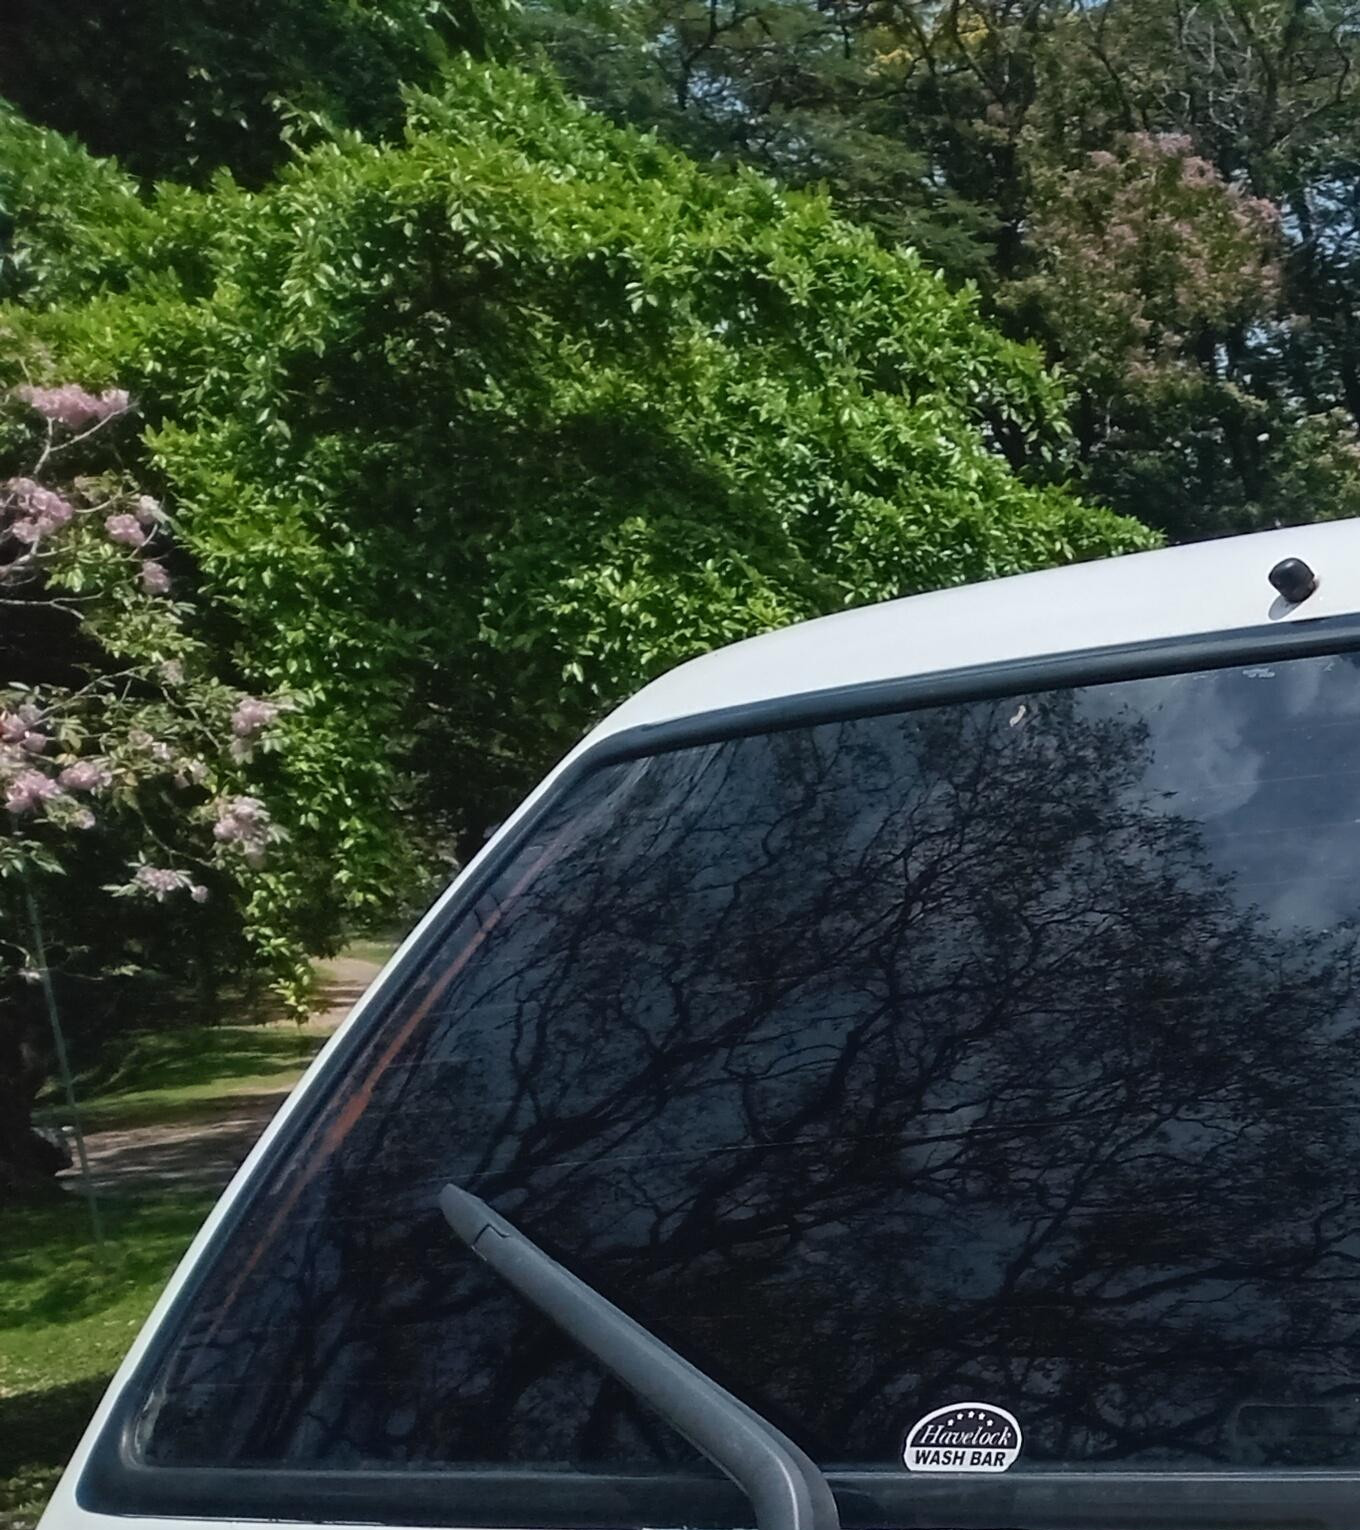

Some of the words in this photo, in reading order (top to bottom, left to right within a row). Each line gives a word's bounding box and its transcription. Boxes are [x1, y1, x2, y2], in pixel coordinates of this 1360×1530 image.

[919, 1424, 1012, 1446] Havelock
[914, 1449, 966, 1466] WASH
[969, 1451, 1007, 1467] BAR
